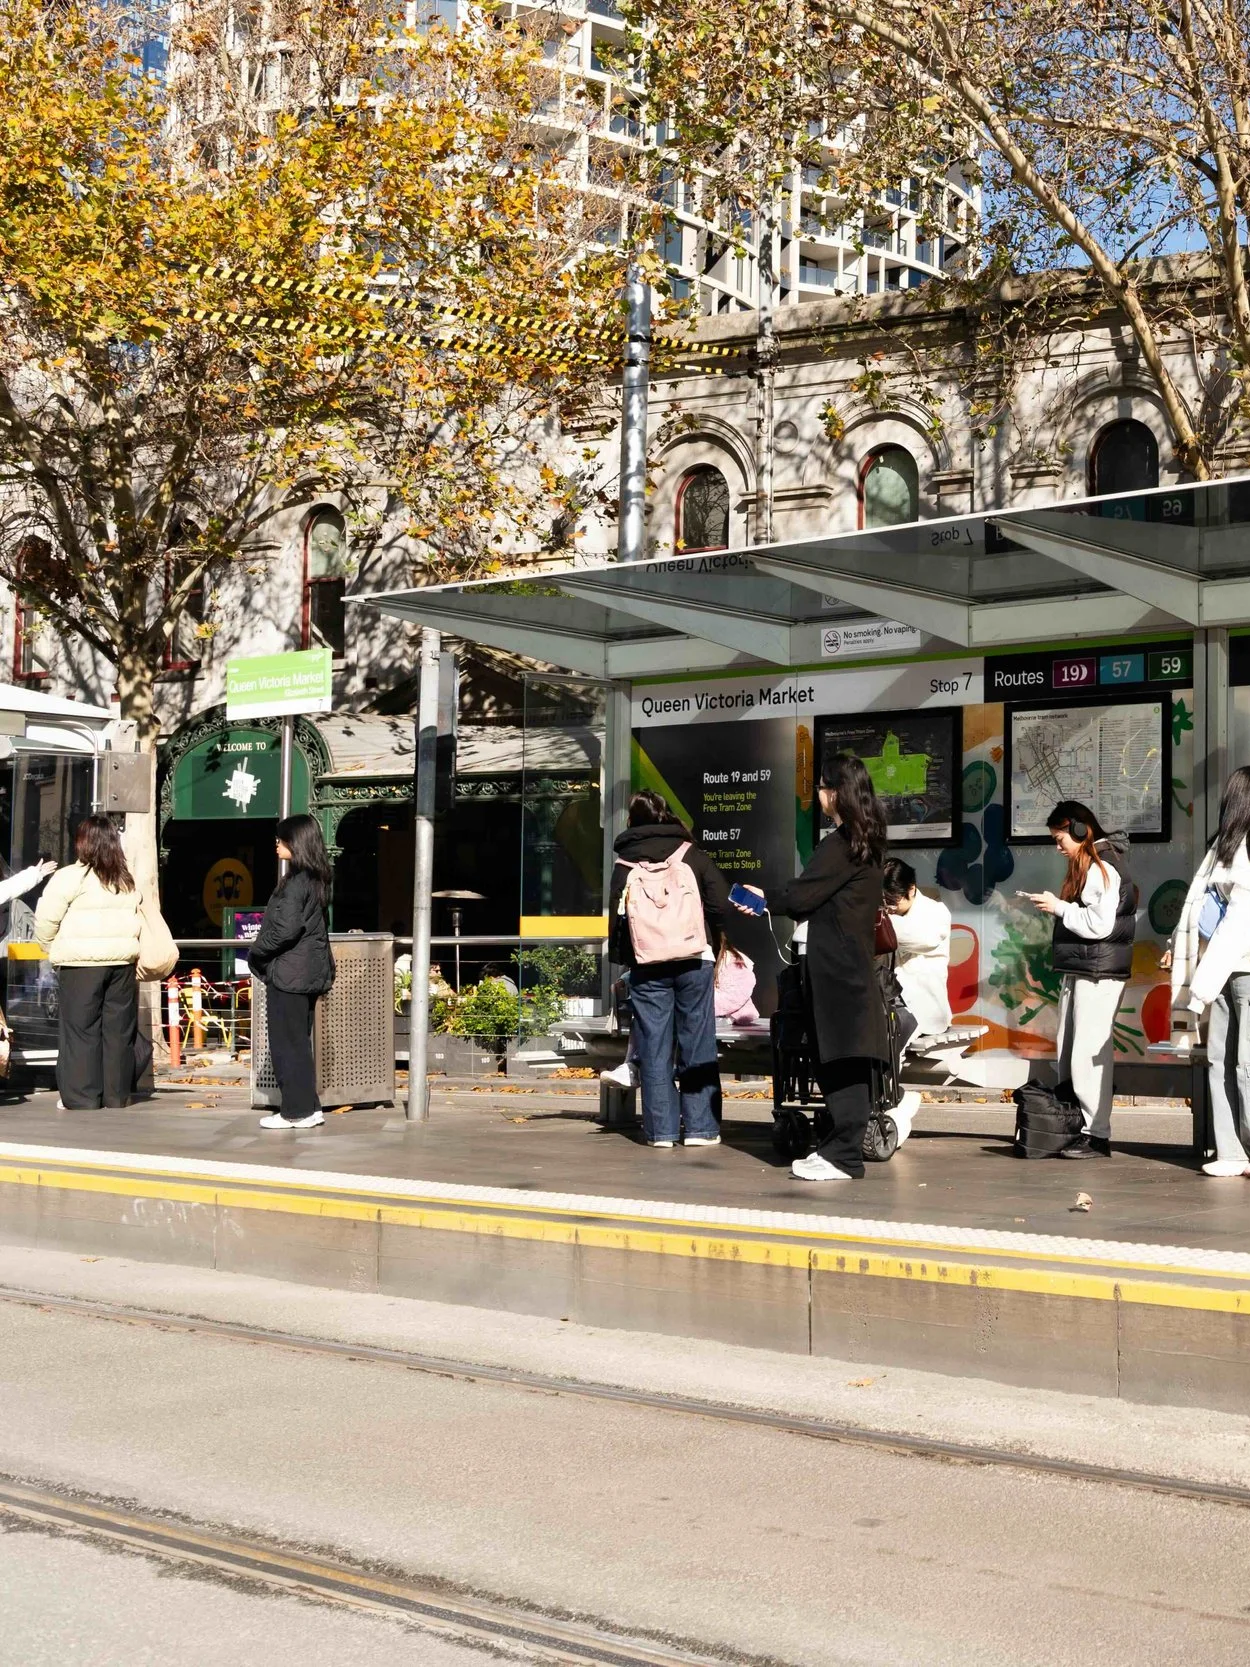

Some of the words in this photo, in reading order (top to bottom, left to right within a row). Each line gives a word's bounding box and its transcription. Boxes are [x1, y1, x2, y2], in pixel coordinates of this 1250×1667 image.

[843, 631, 852, 640] No
[884, 626, 893, 634] No
[994, 669, 1044, 687] Routes
[1112, 661, 1131, 678] 57
[1161, 657, 1182, 674] 59
[229, 680, 256, 693] Queen
[258, 675, 290, 689] Victoria
[293, 671, 324, 685] Market
[930, 678, 959, 695] Stop
[962, 672, 973, 691] 7
[641, 697, 690, 718] Queen
[695, 690, 754, 710] Victoria
[759, 686, 815, 706] Market
[216, 742, 252, 752] WELCOME
[256, 742, 266, 750] TO
[703, 772, 729, 784] Route
[731, 771, 740, 782] 19
[742, 770, 758, 782] and
[760, 769, 771, 781] 59
[703, 793, 722, 801] You're
[723, 791, 745, 802] leaving
[746, 791, 757, 800] the
[703, 804, 718, 812] Free
[719, 803, 735, 812] Tram
[736, 802, 752, 811] Zone
[702, 829, 728, 840] Route
[730, 828, 741, 839] 57
[718, 849, 735, 857] Tram
[736, 849, 752, 857] Zone
[741, 860, 755, 870] Stop
[757, 860, 761, 868] 8
